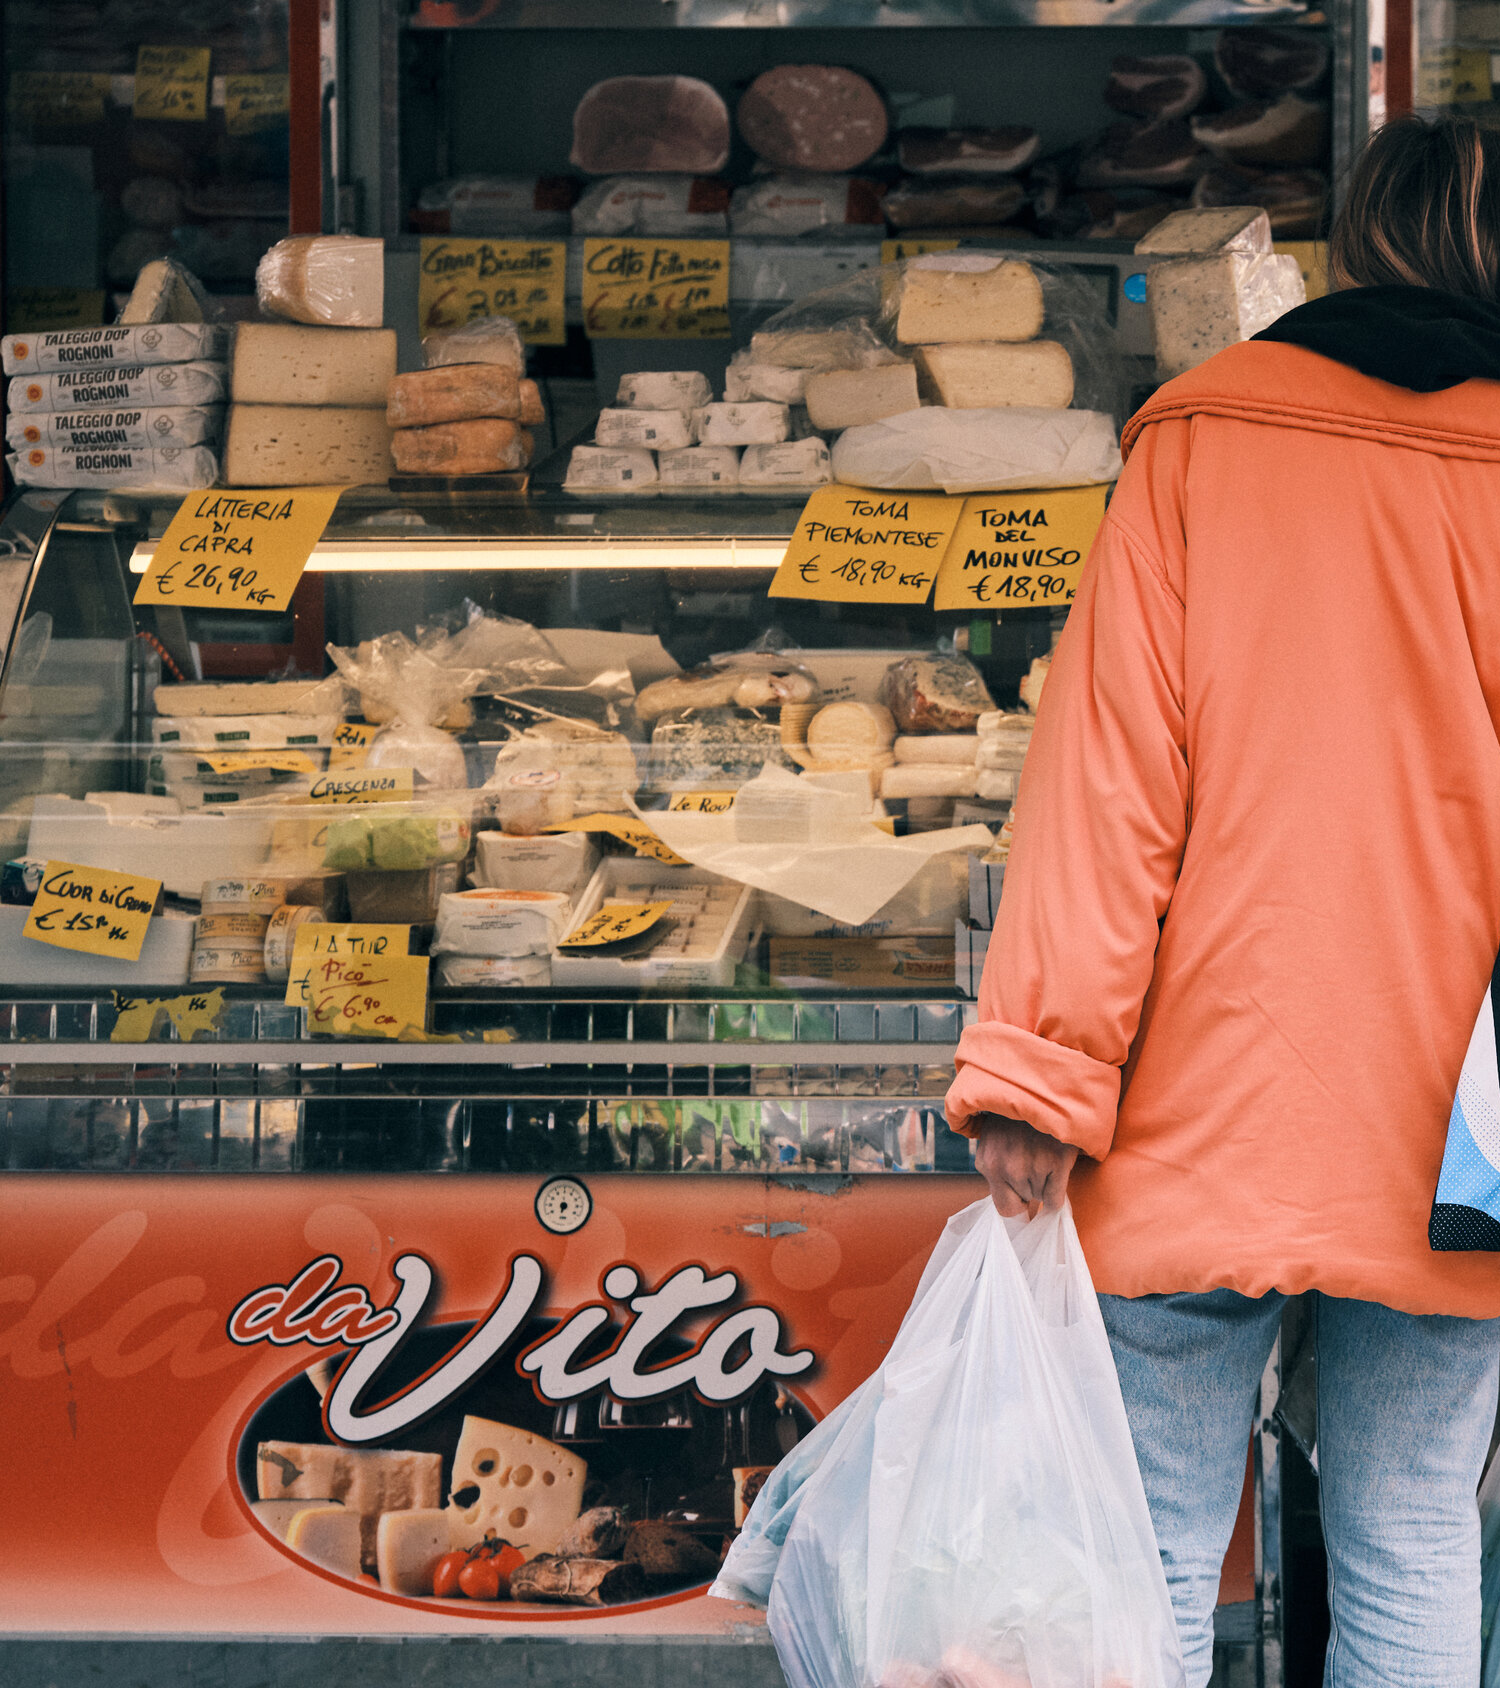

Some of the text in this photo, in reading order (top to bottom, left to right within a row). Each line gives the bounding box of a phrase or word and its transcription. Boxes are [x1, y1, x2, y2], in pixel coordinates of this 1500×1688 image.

[45, 329, 130, 346] TALEGGIO DOP
[58, 345, 114, 361] ROGNONI
[58, 368, 144, 387] TALEGGIO DOP
[73, 384, 129, 402] ROGNONI
[55, 412, 141, 430] TALEGGIO DOP
[71, 430, 128, 445] ROGNONI
[76, 454, 132, 470] ROGNONI
[194, 496, 294, 520] LATTERIA
[846, 500, 908, 521] TOMA
[974, 508, 1048, 527] TOMA
[213, 521, 230, 534] DI
[805, 521, 944, 548] PIEMONTESE
[995, 530, 1036, 543] DEL
[179, 535, 254, 555] CAPRA
[963, 547, 1081, 571] MONVISO
[799, 555, 931, 588] € 18,90 KG
[155, 561, 275, 604] € 26,90 KG
[967, 575, 992, 601] €
[311, 776, 396, 799] CRESCENZA
[34, 908, 64, 931] €
[313, 995, 334, 1022] €
[228, 1254, 815, 1442] da Vito
